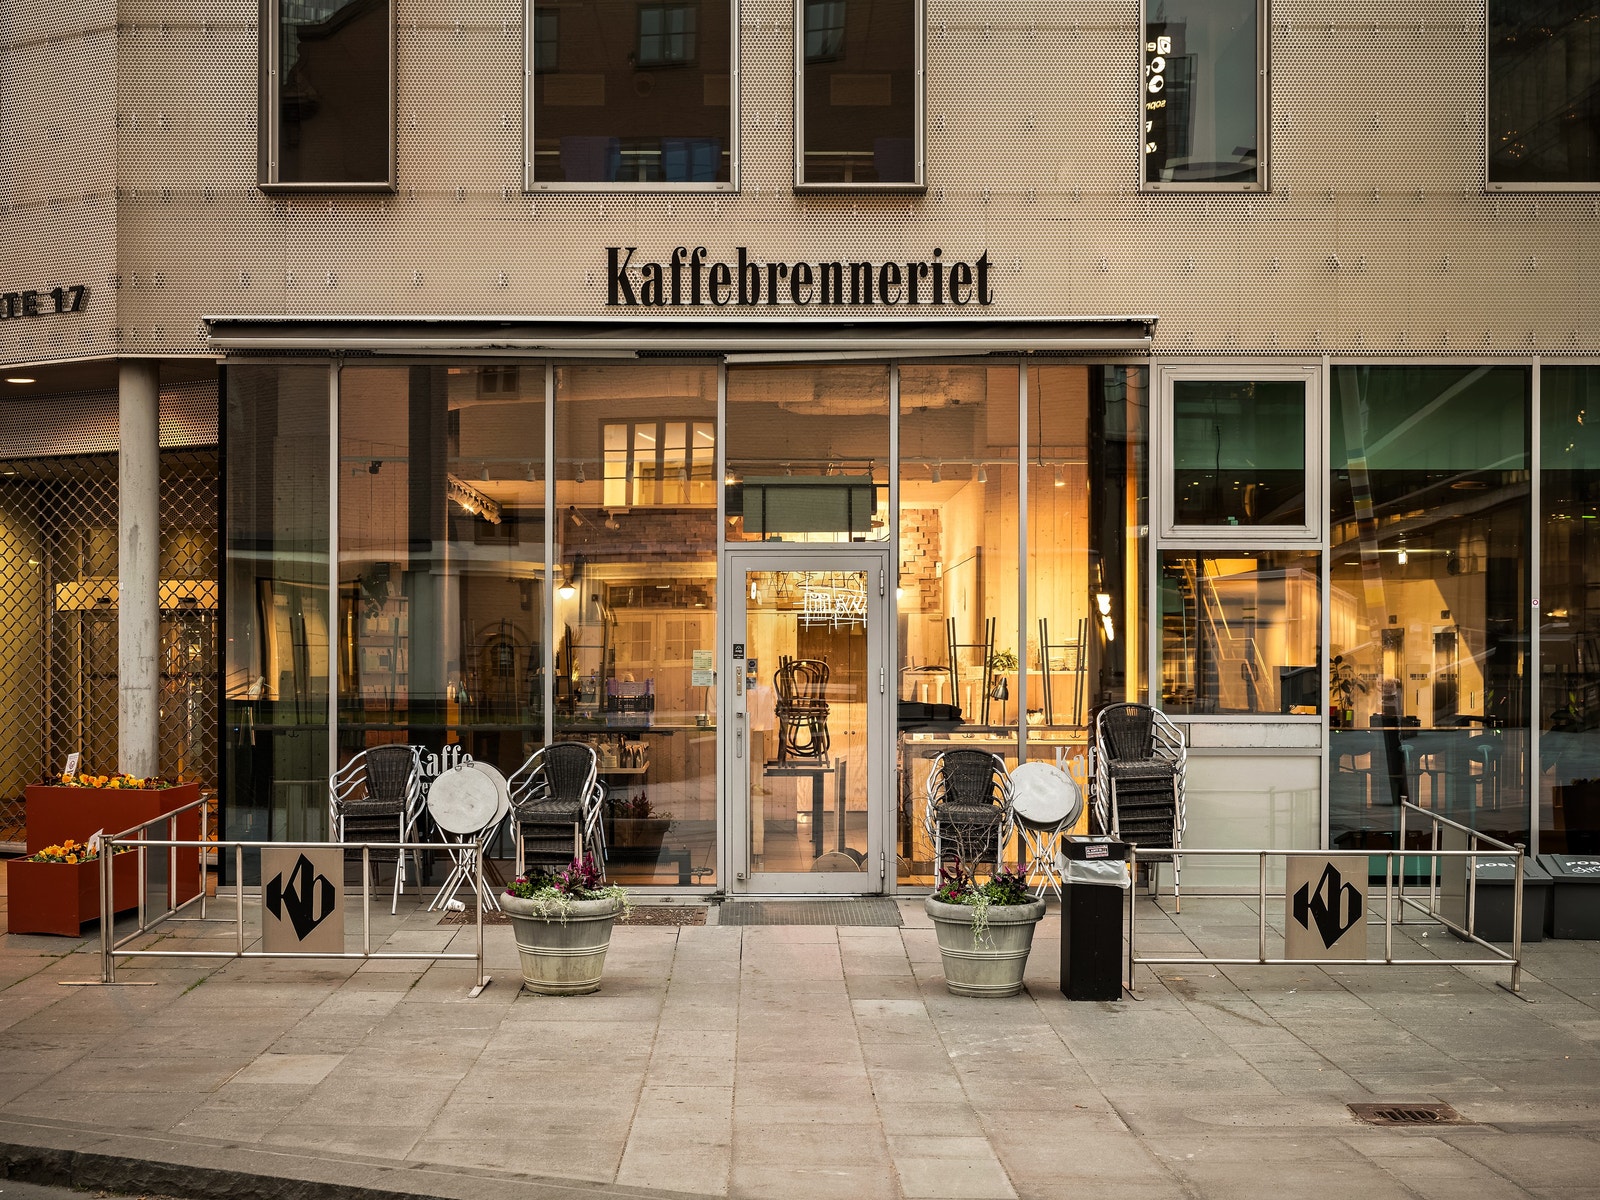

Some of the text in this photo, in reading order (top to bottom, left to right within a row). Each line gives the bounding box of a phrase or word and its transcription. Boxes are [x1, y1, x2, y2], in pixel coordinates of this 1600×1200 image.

[605, 246, 993, 306] Kaffebrenneriet
[50, 285, 85, 313] 17
[1055, 746, 1097, 777] Kaf
